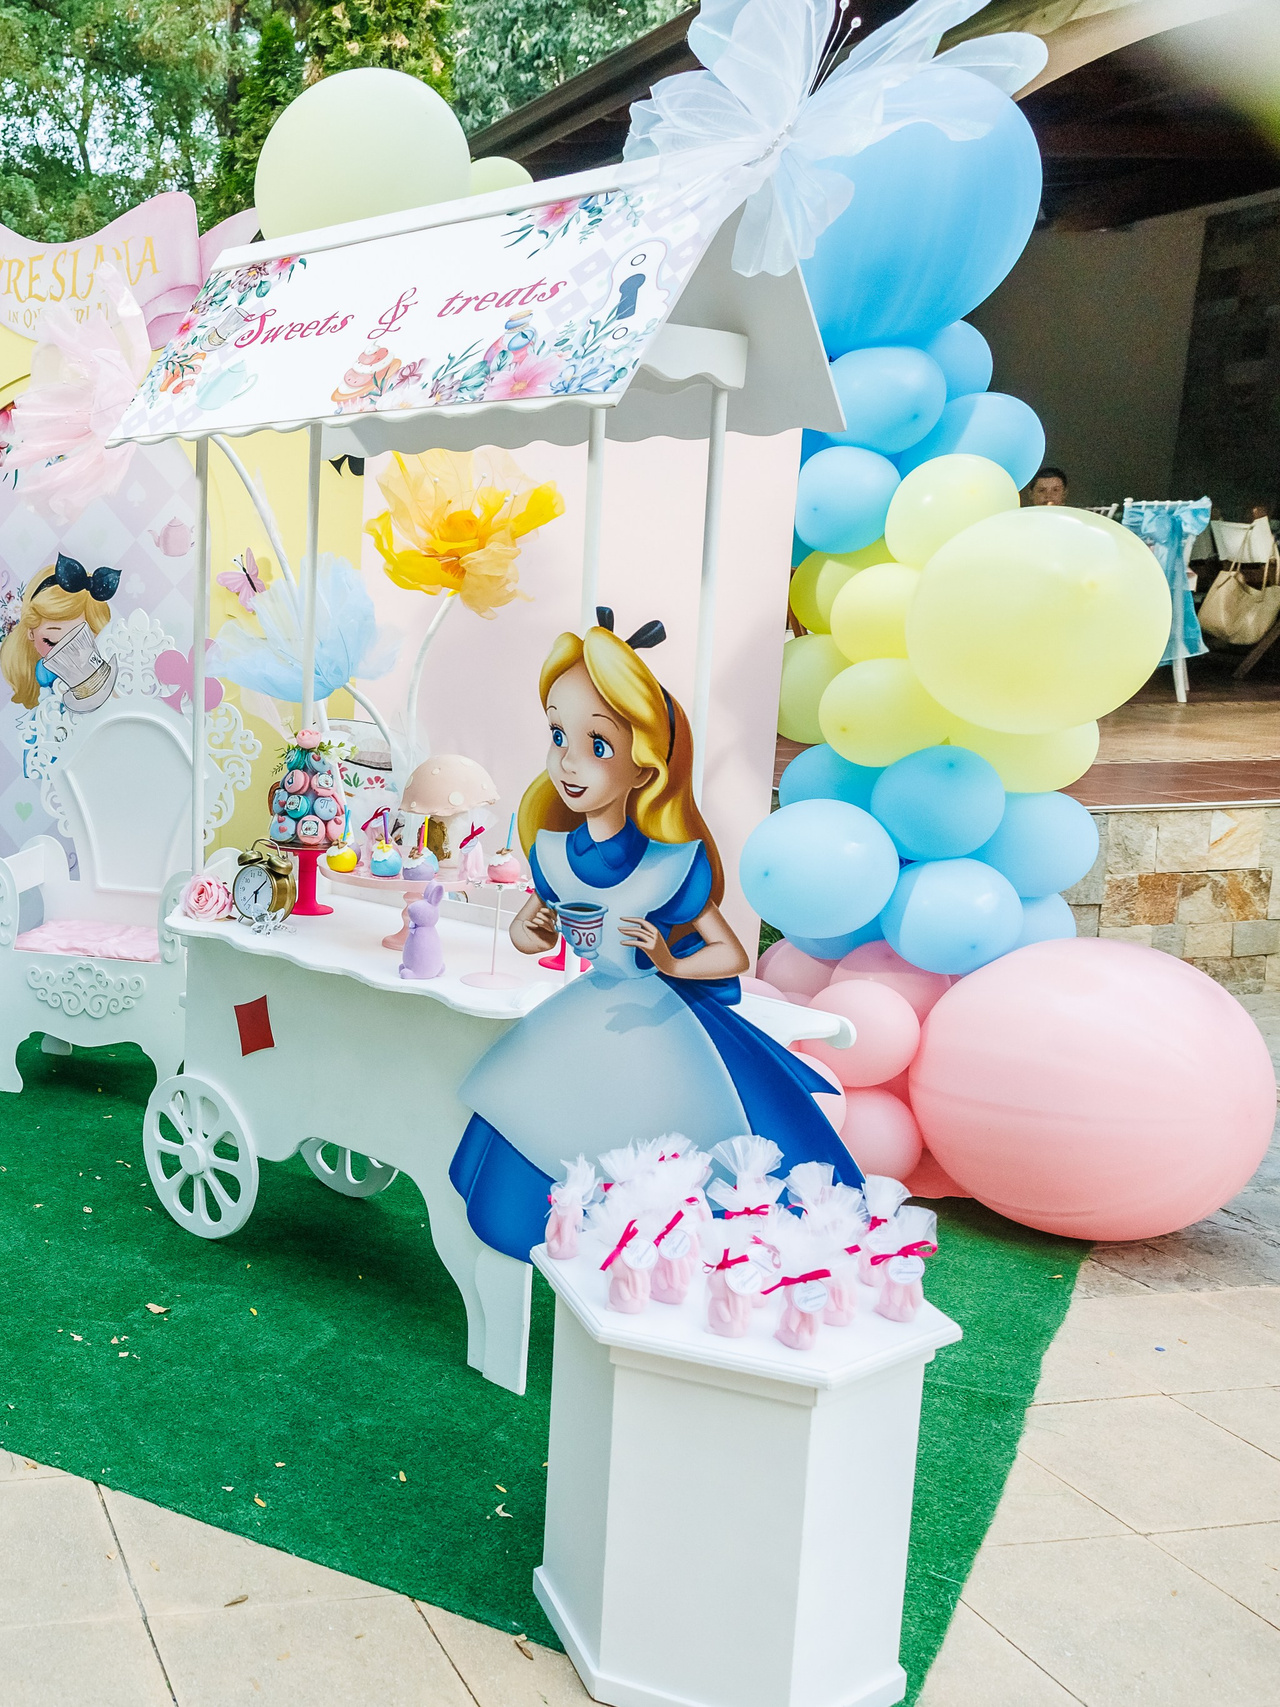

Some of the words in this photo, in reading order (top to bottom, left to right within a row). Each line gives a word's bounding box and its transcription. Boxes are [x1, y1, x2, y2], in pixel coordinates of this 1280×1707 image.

[234, 307, 355, 349] Sweets
[367, 286, 419, 340] &
[436, 276, 568, 318] treats
